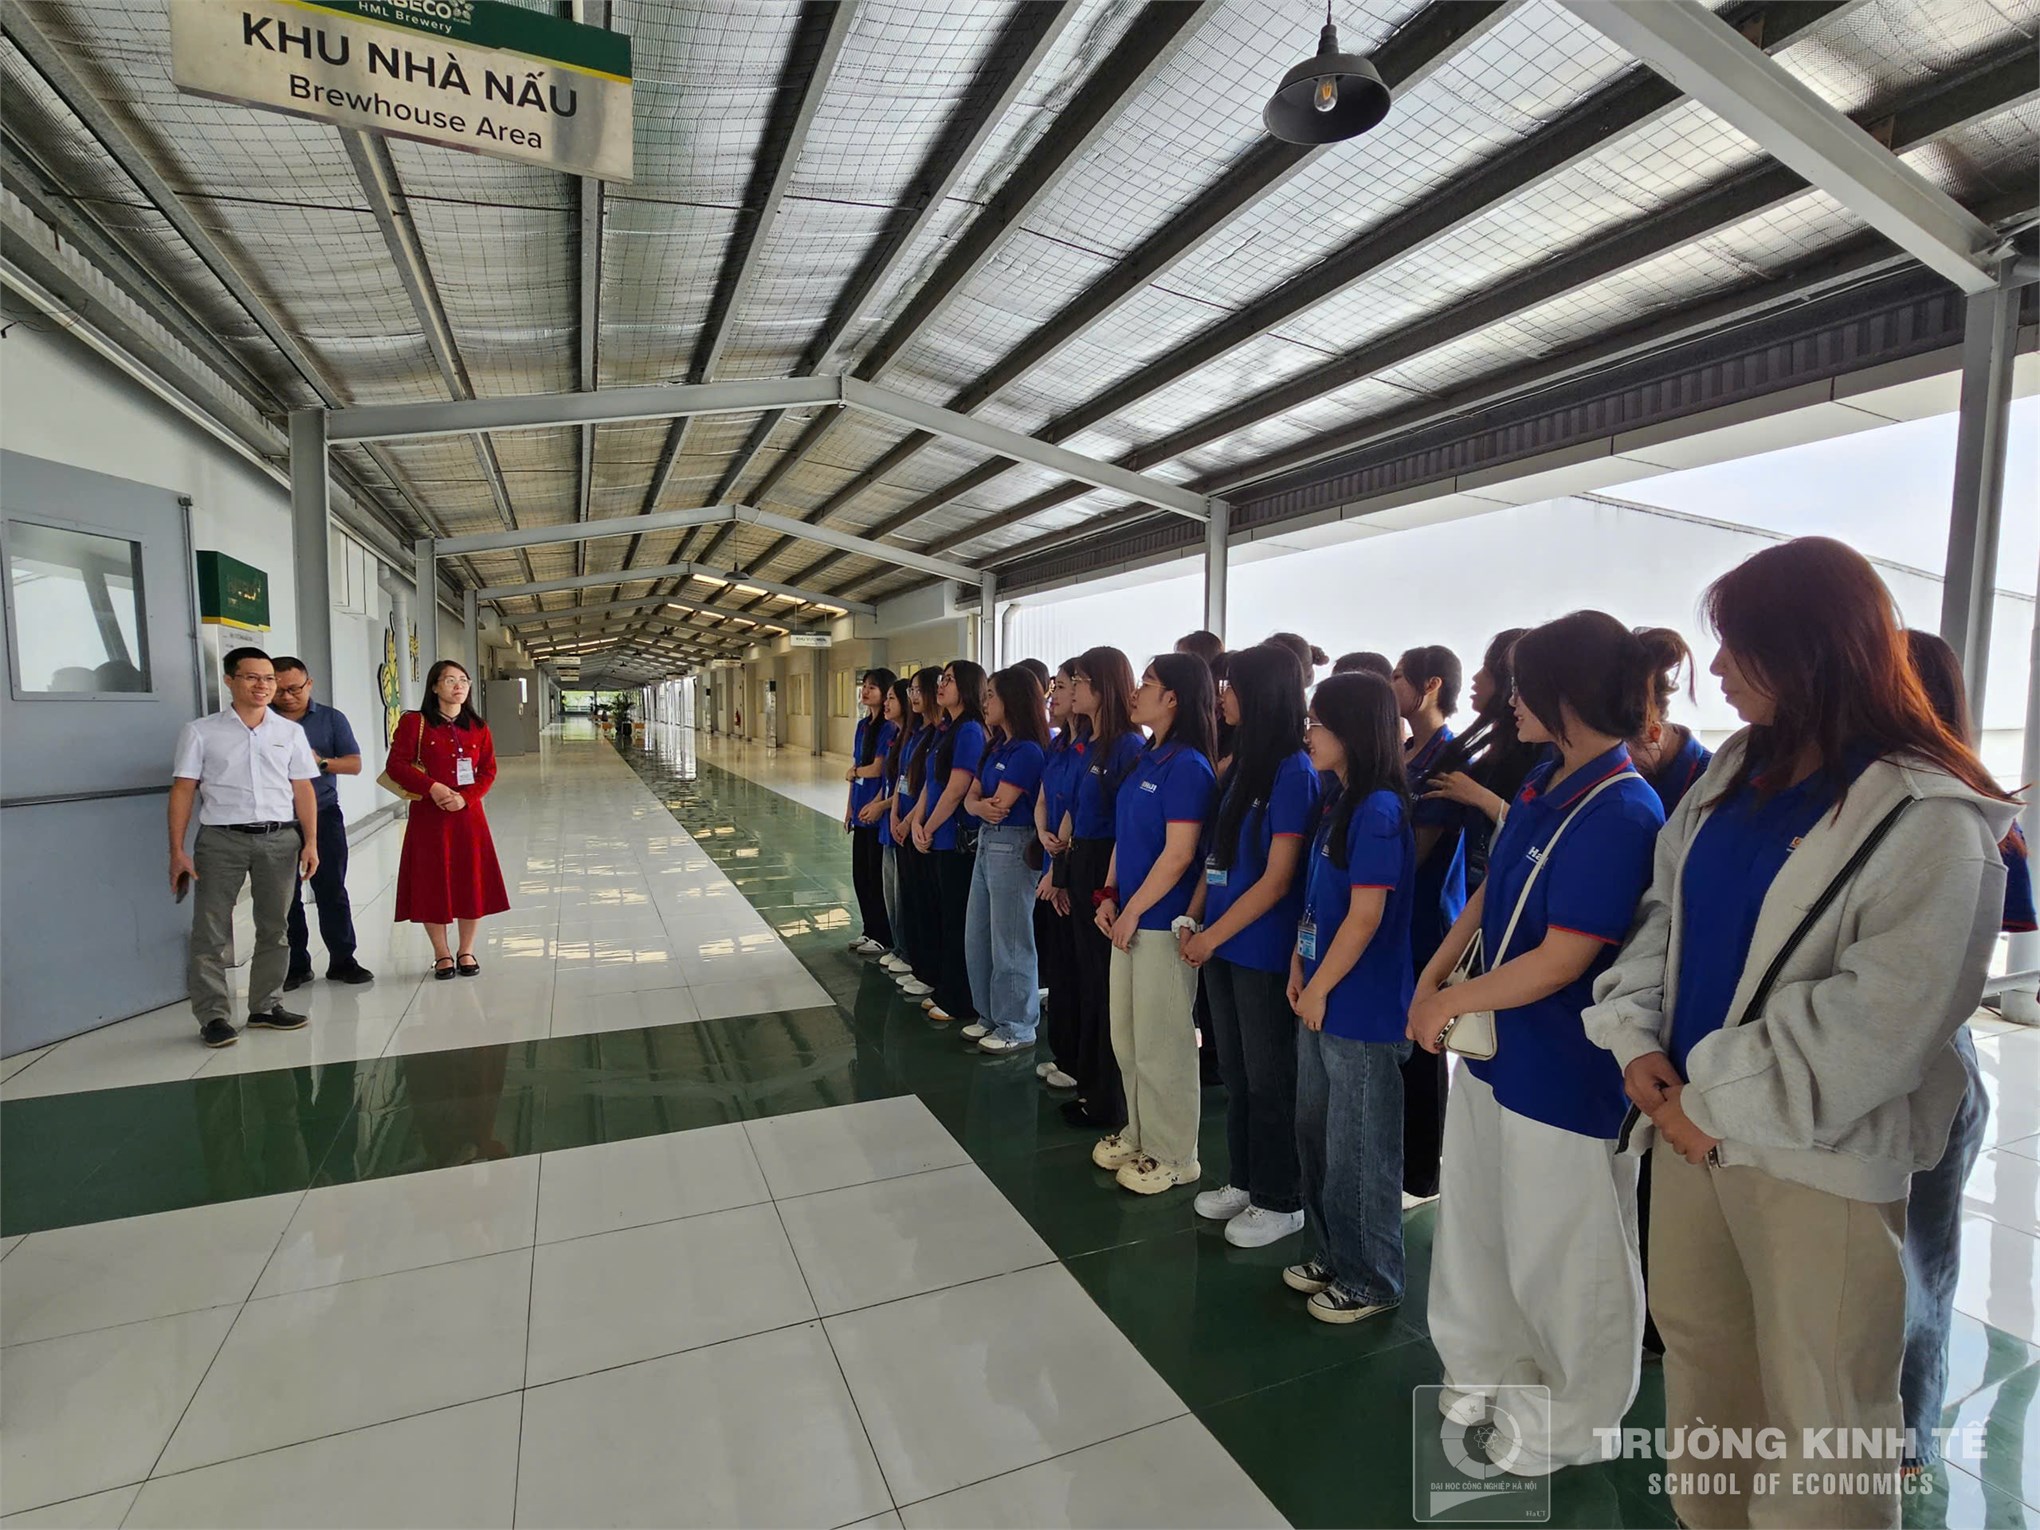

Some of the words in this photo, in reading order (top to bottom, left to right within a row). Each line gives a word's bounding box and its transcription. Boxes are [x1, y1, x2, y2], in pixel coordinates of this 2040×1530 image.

[359, 2, 390, 17] HML
[395, 9, 452, 34] Brewery
[377, 0, 452, 19] BECO
[243, 12, 350, 66] KHU
[368, 42, 472, 96] NHÀ
[485, 70, 577, 118] NẤU
[290, 74, 466, 133] Brewhouse
[476, 116, 542, 149] Area
